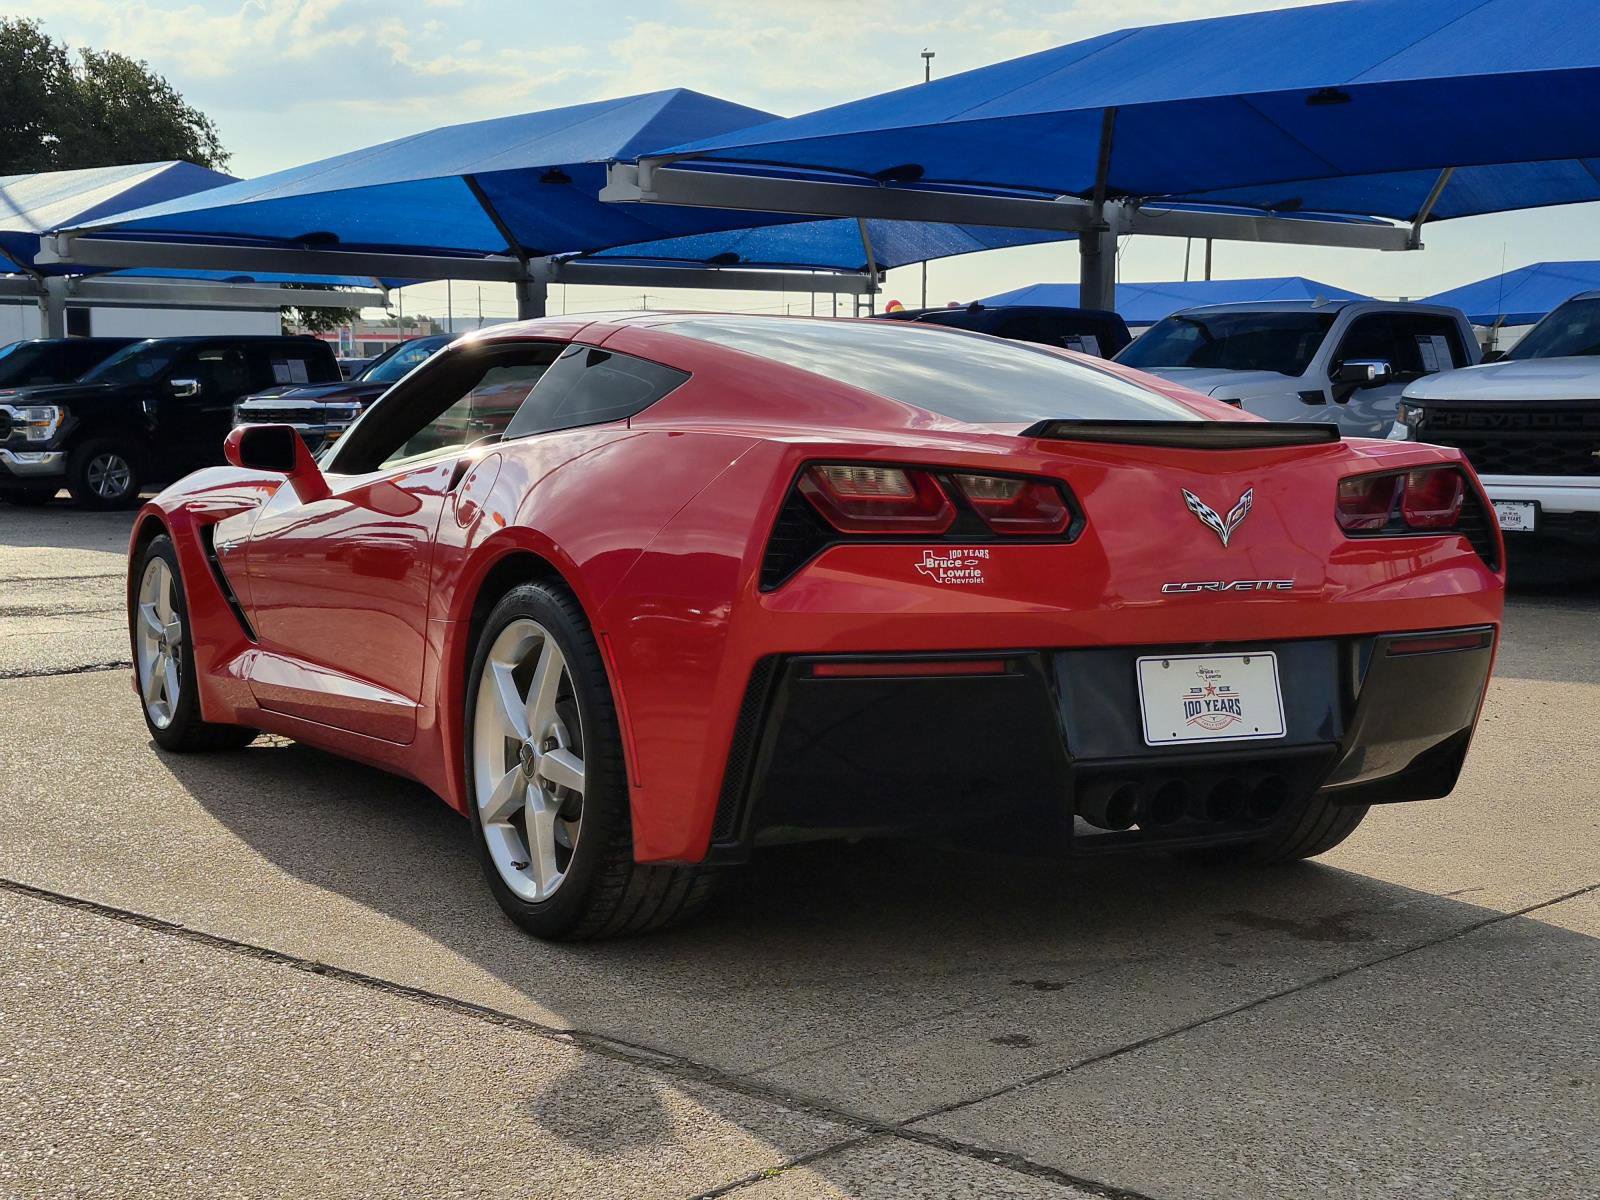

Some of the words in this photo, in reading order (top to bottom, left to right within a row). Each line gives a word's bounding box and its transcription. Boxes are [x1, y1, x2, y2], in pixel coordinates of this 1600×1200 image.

[949, 550, 962, 560] 100
[963, 549, 989, 559] YEARS
[926, 558, 962, 568] Bruce
[939, 567, 981, 577] Lowrie
[1161, 580, 1294, 593] CORVETTE
[1183, 700, 1202, 720] 100
[1204, 698, 1242, 716] YEARS
